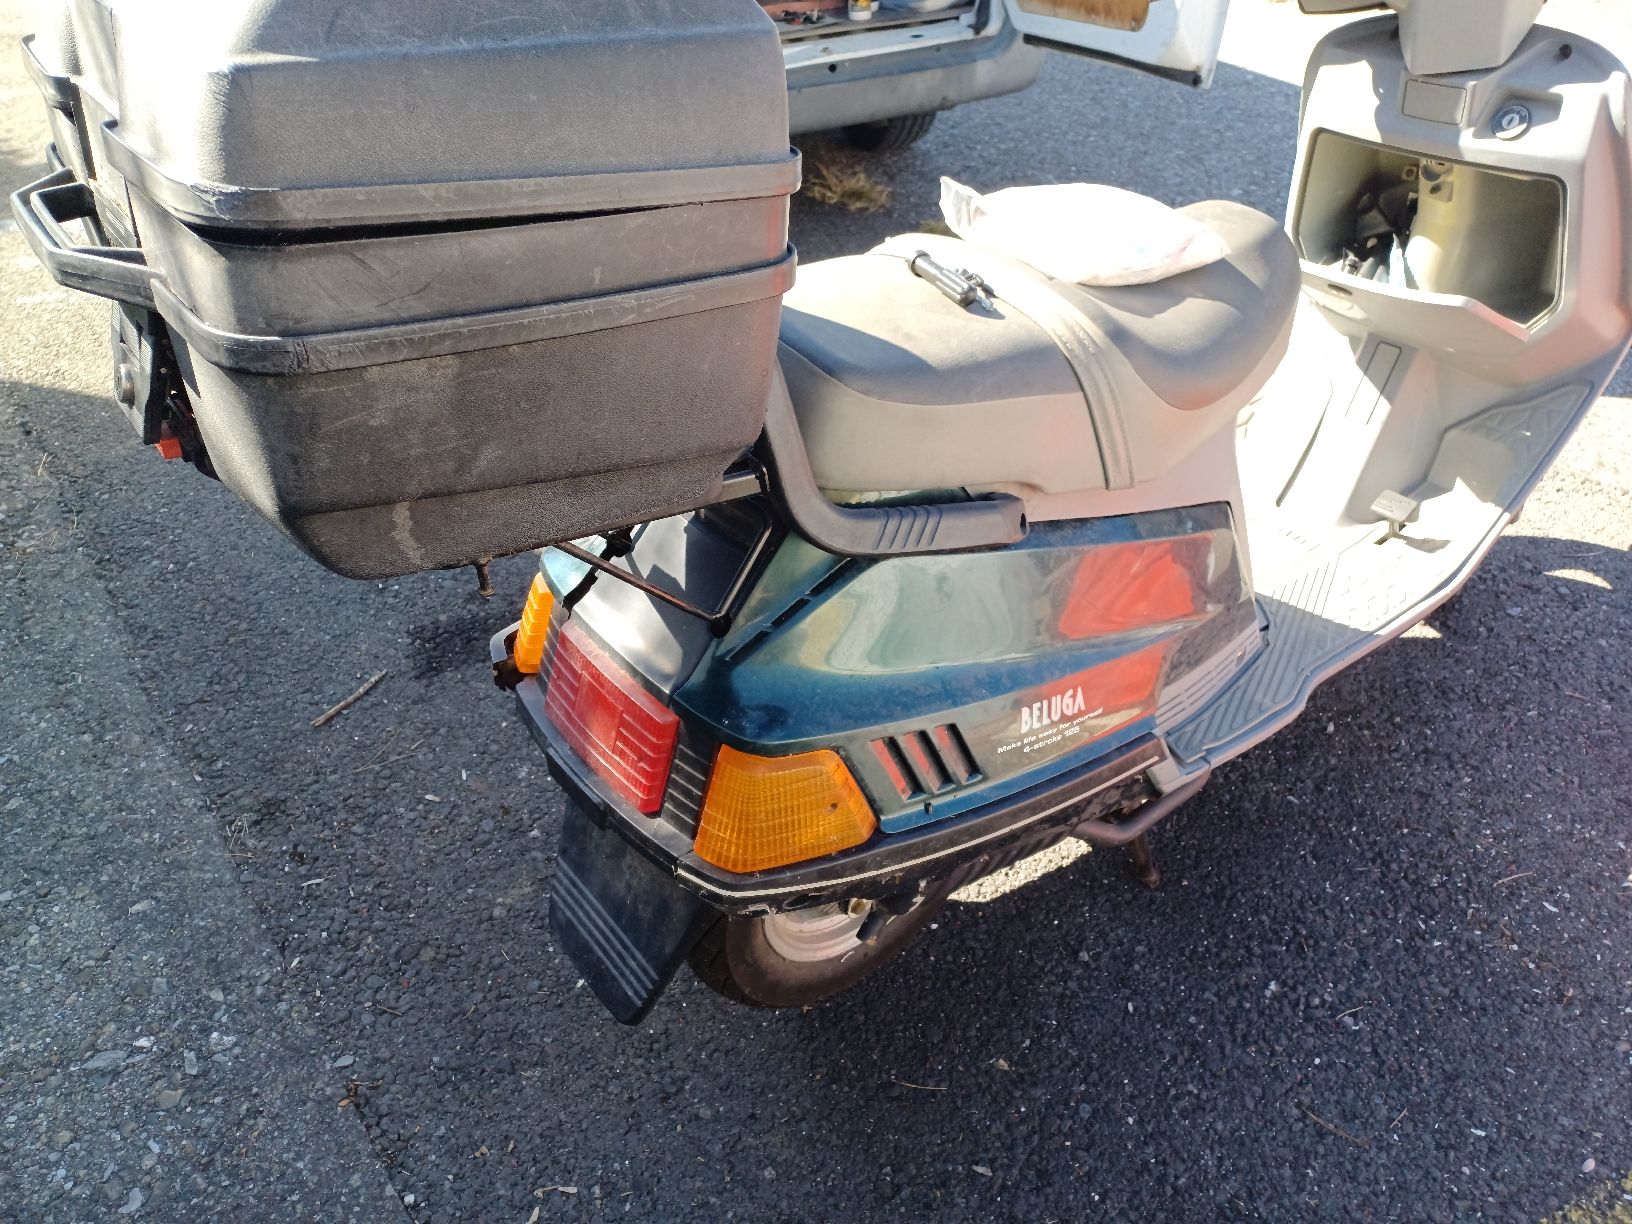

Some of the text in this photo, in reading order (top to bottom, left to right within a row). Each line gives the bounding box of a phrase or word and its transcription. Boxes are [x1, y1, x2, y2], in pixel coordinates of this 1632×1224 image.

[997, 707, 1104, 753] Make life easy for yourself
[1020, 686, 1085, 734] BELUGA
[1023, 726, 1081, 753] 4-stroke 125
